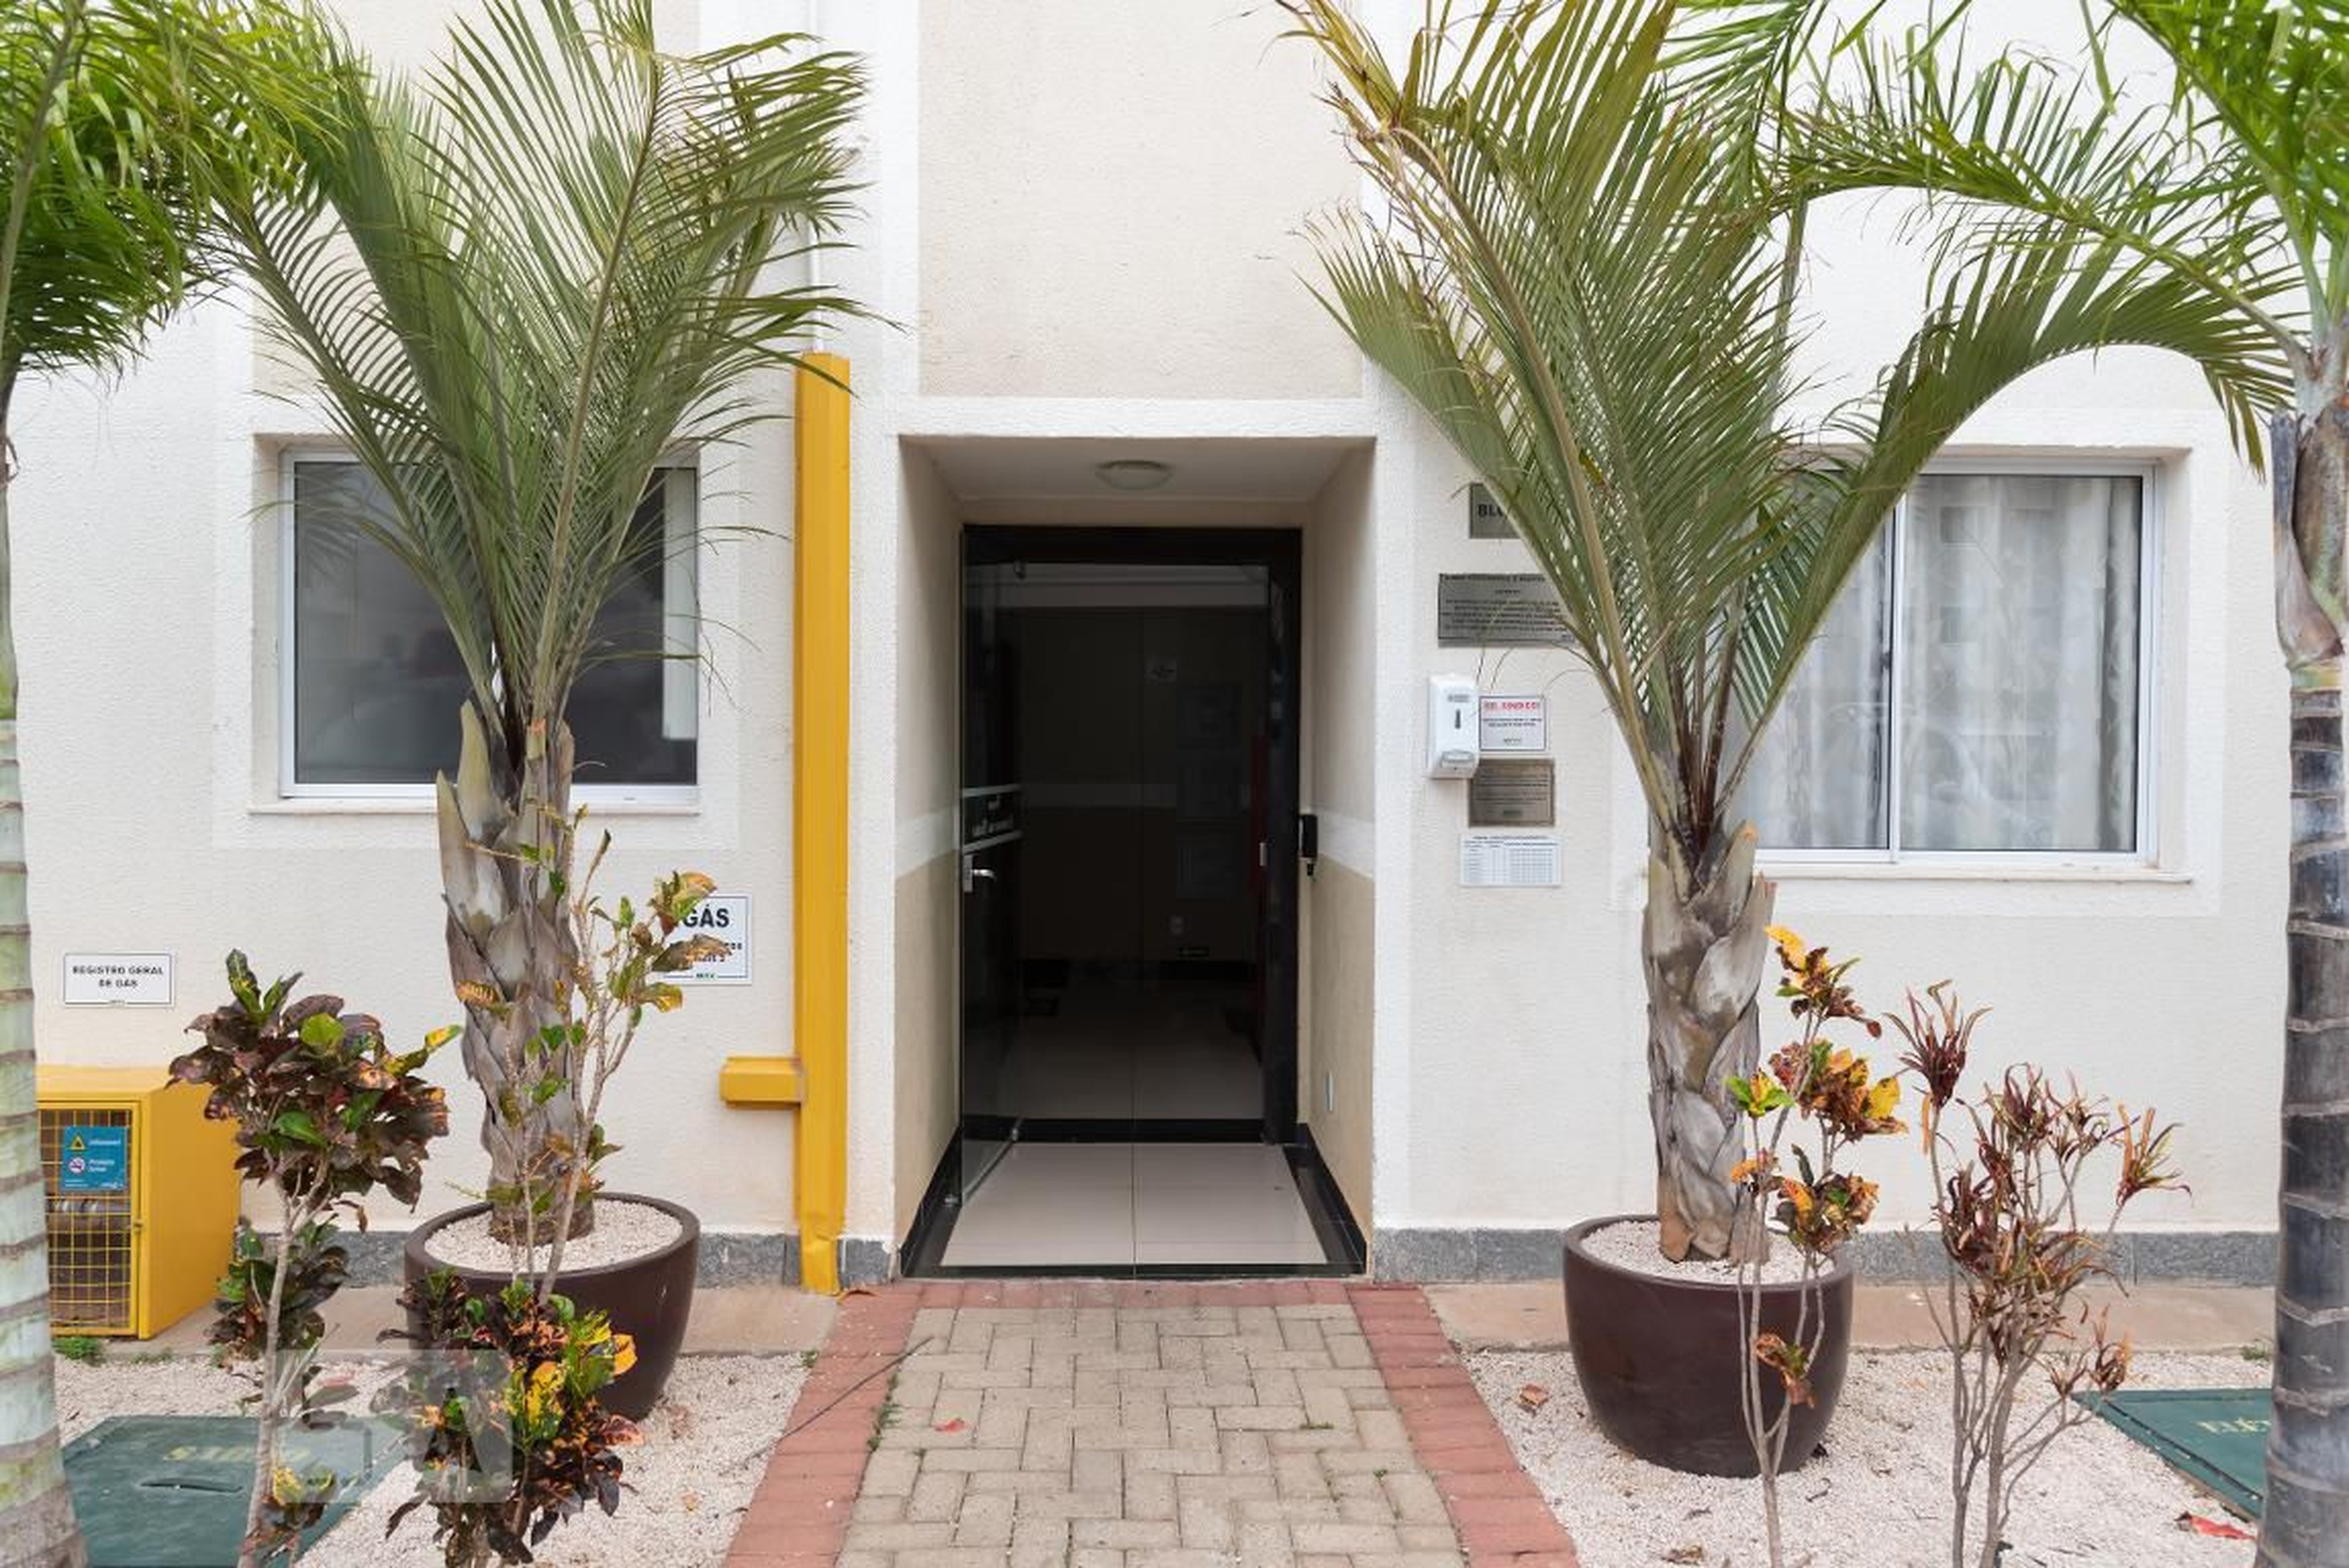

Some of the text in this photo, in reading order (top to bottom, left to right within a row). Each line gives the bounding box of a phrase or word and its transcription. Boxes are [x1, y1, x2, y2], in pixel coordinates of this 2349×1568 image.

[683, 904, 730, 928] GÁS
[73, 966, 163, 974] REGISTRO GERAL
